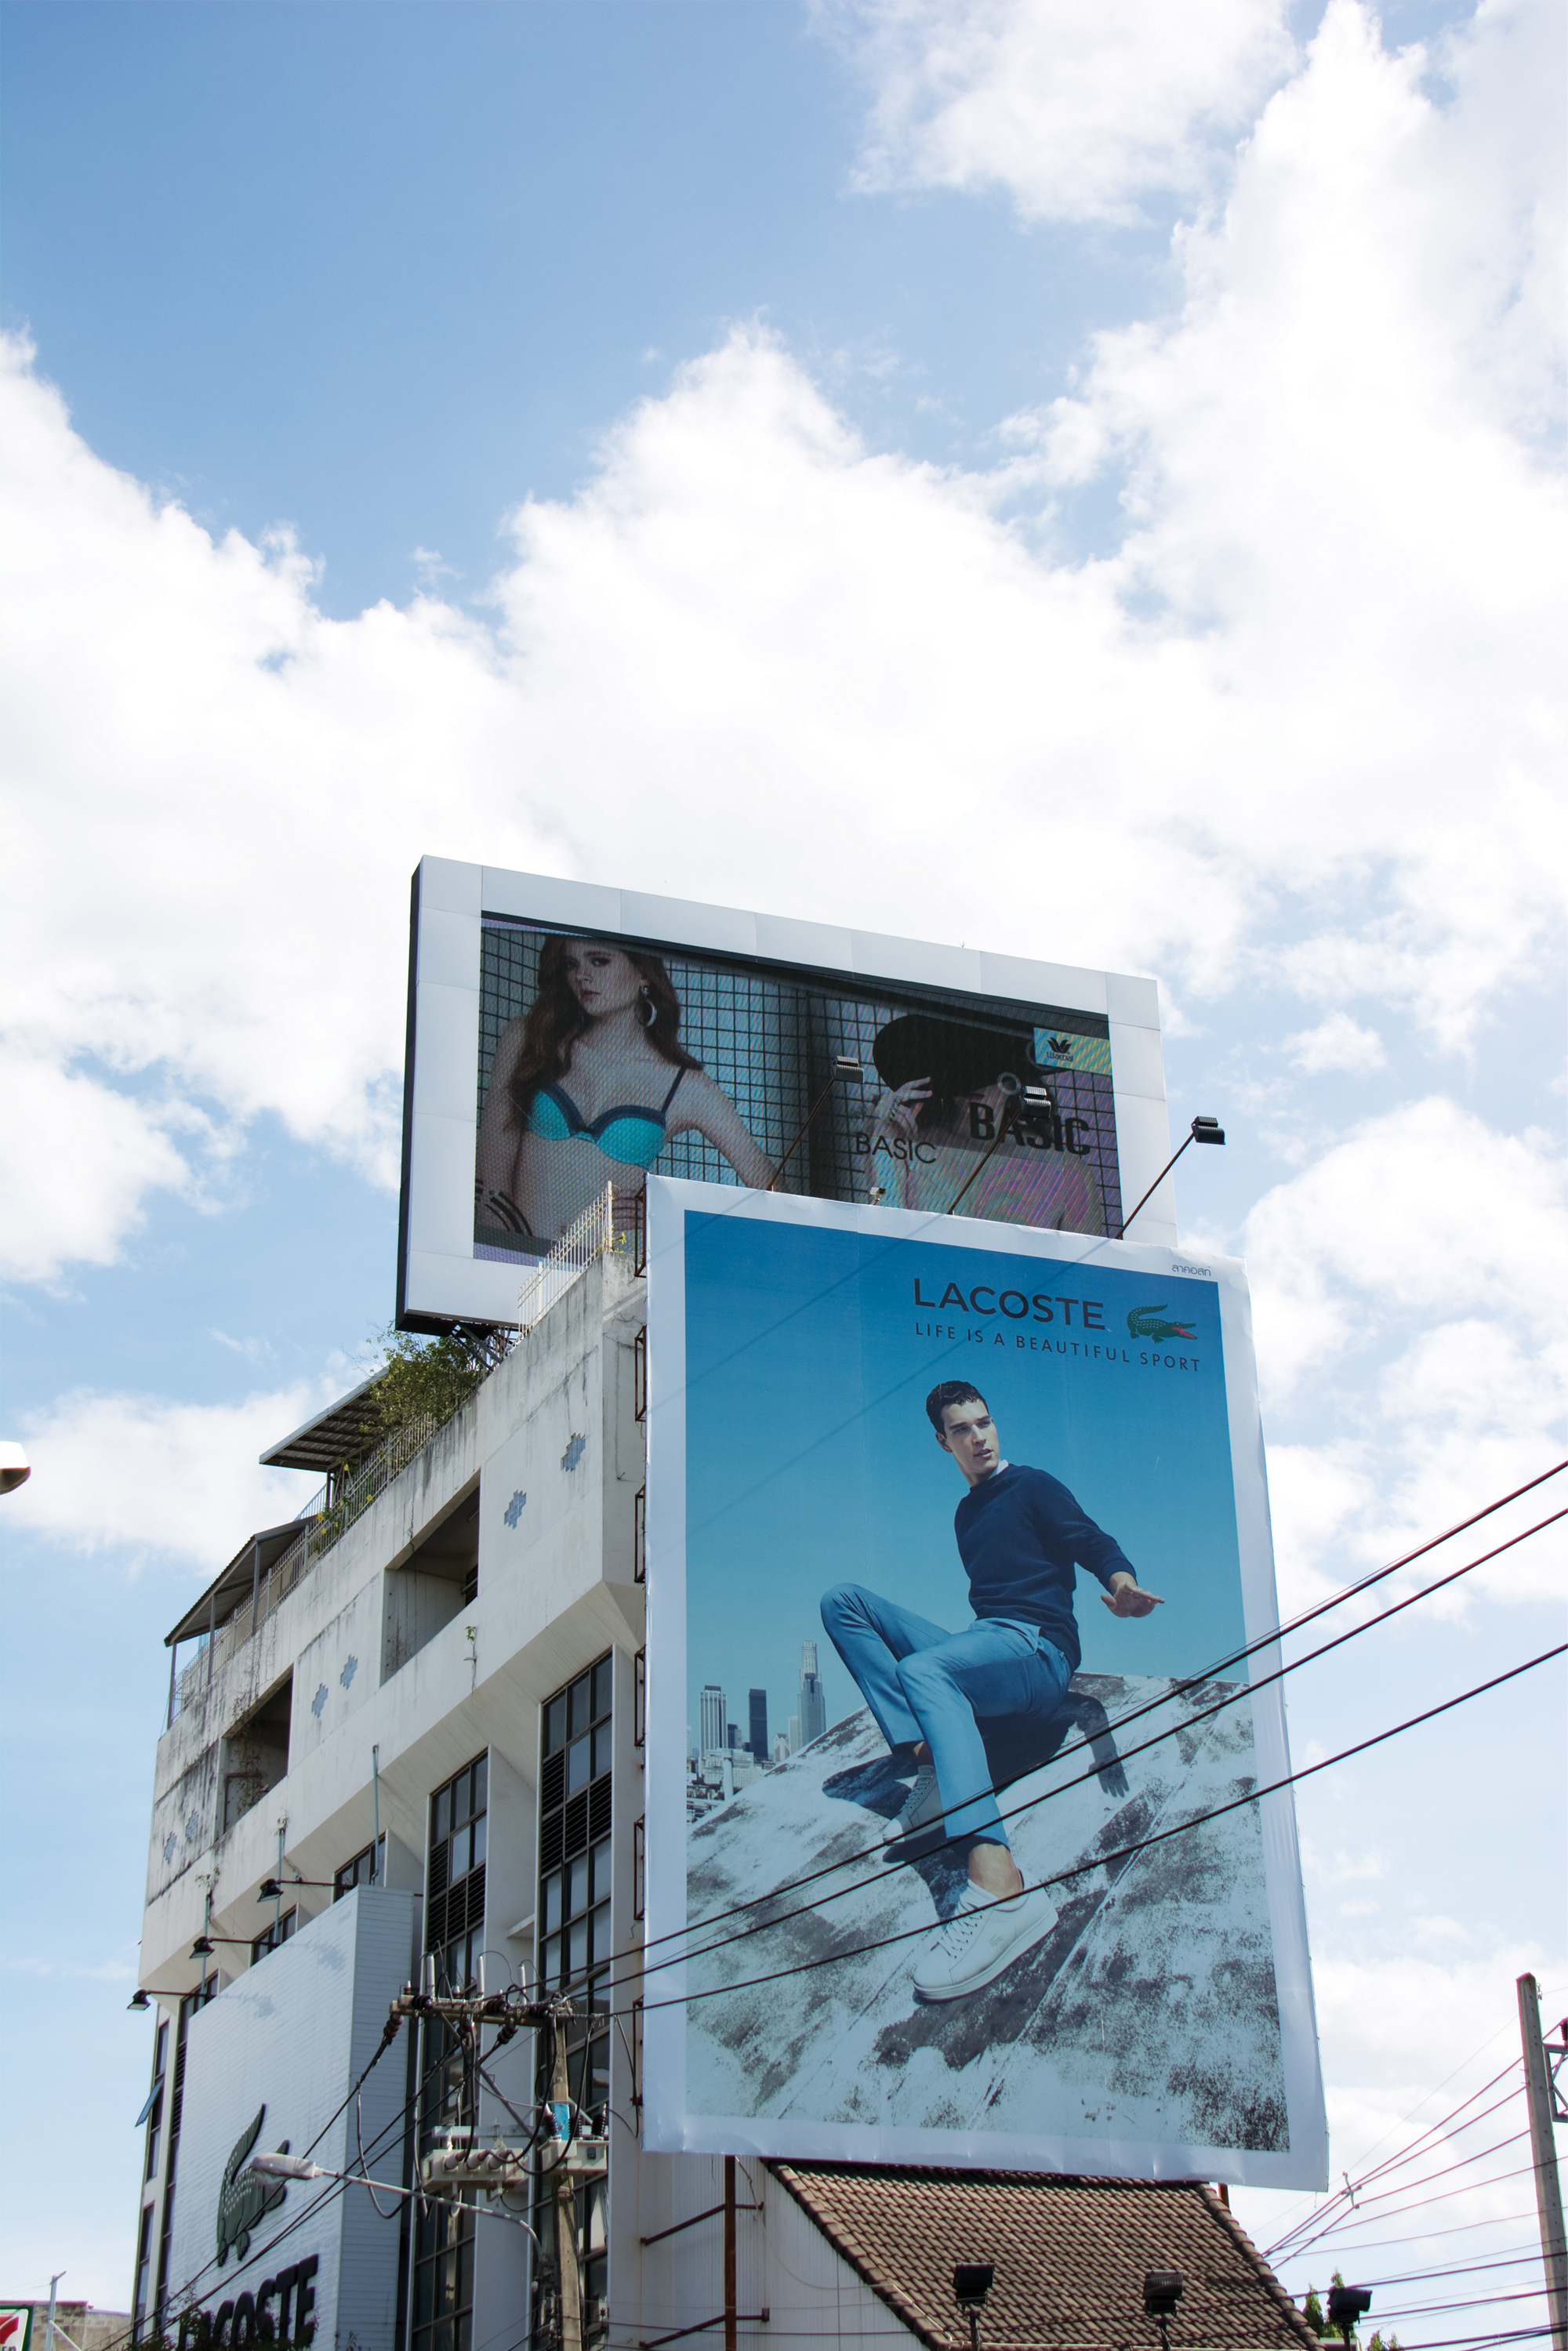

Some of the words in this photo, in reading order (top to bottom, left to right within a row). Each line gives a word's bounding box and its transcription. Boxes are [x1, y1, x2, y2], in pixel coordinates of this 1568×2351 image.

[1047, 1051, 1073, 1062] Wacoal
[855, 1131, 937, 1164] BASIC
[969, 1101, 1091, 1156] BASIC
[913, 1277, 1106, 1330] LACOSTE
[915, 1322, 956, 1340] LIFE
[967, 1329, 984, 1343] IS
[993, 1333, 1005, 1346] A
[1016, 1336, 1130, 1363] BEAUTIFUL
[1139, 1352, 1200, 1372] SPORT
